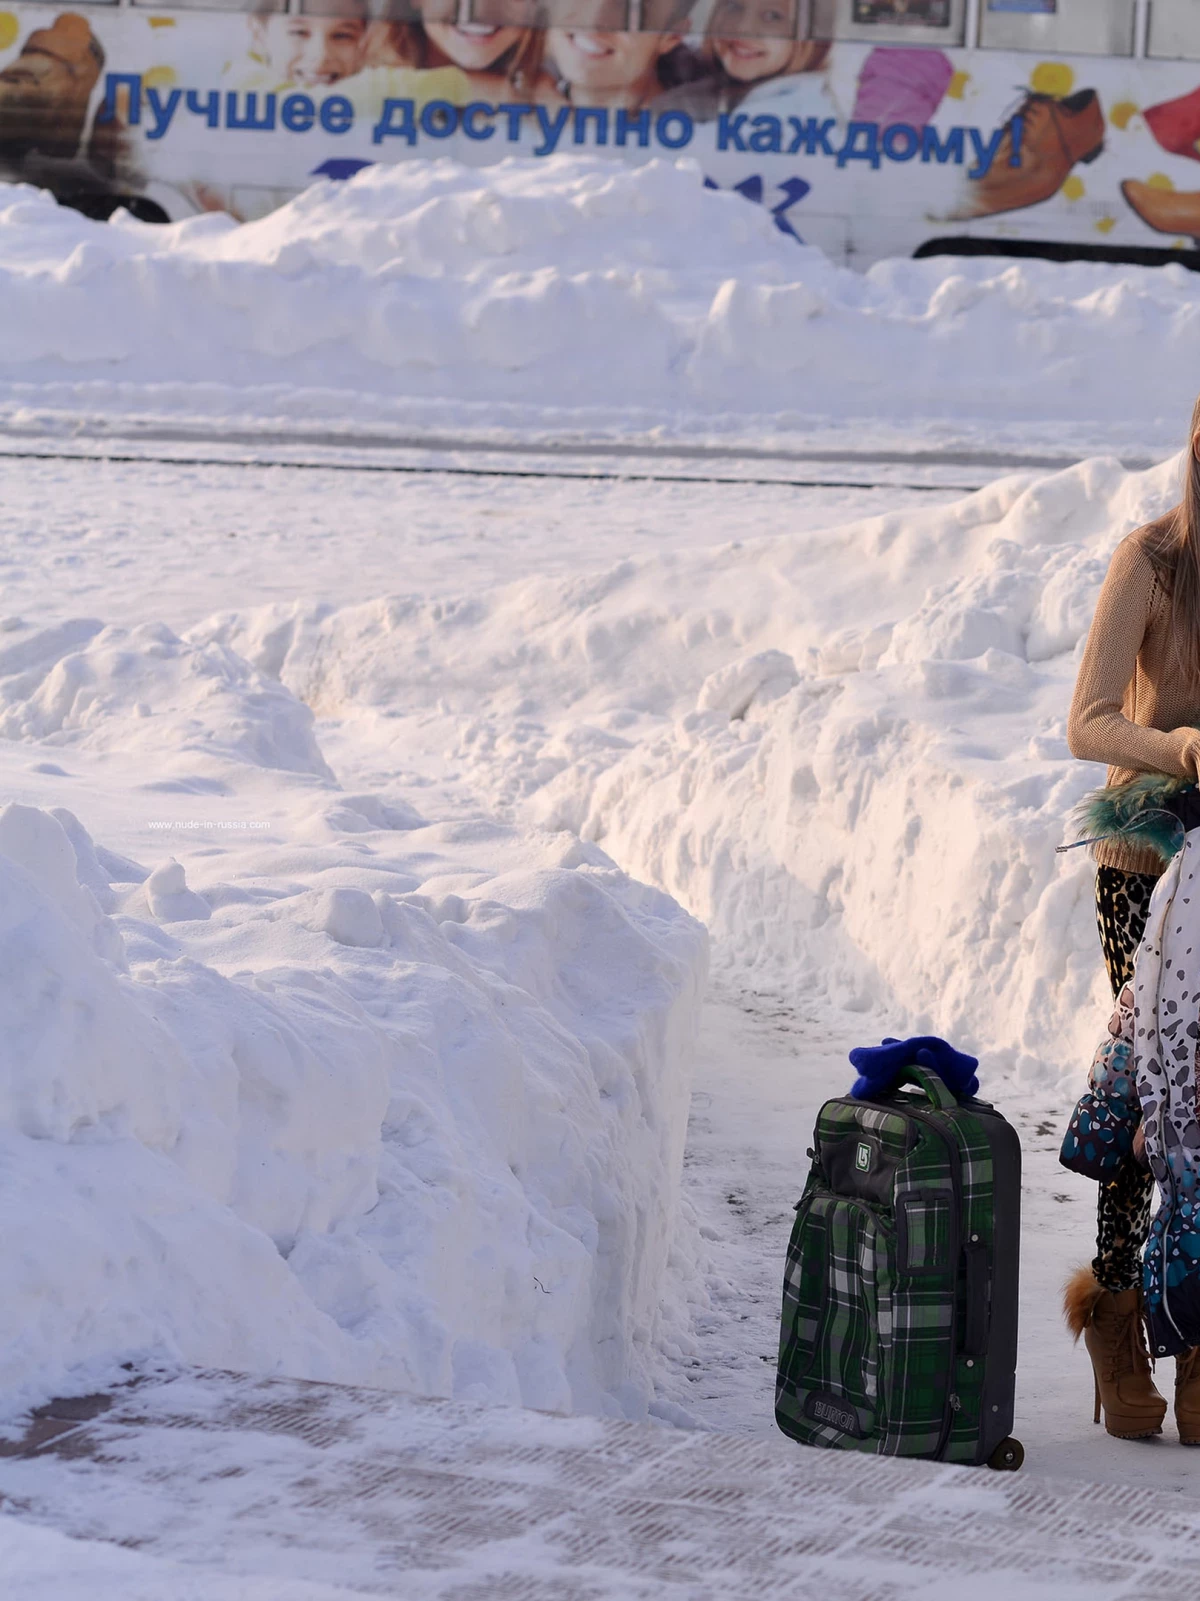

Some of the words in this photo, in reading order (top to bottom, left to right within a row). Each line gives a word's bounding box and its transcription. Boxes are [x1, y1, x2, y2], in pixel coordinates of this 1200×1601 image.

[97, 73, 354, 140] Лучшее
[372, 97, 694, 155] доступно
[717, 113, 1024, 180] каждому!
[814, 1400, 854, 1431] BURTON
